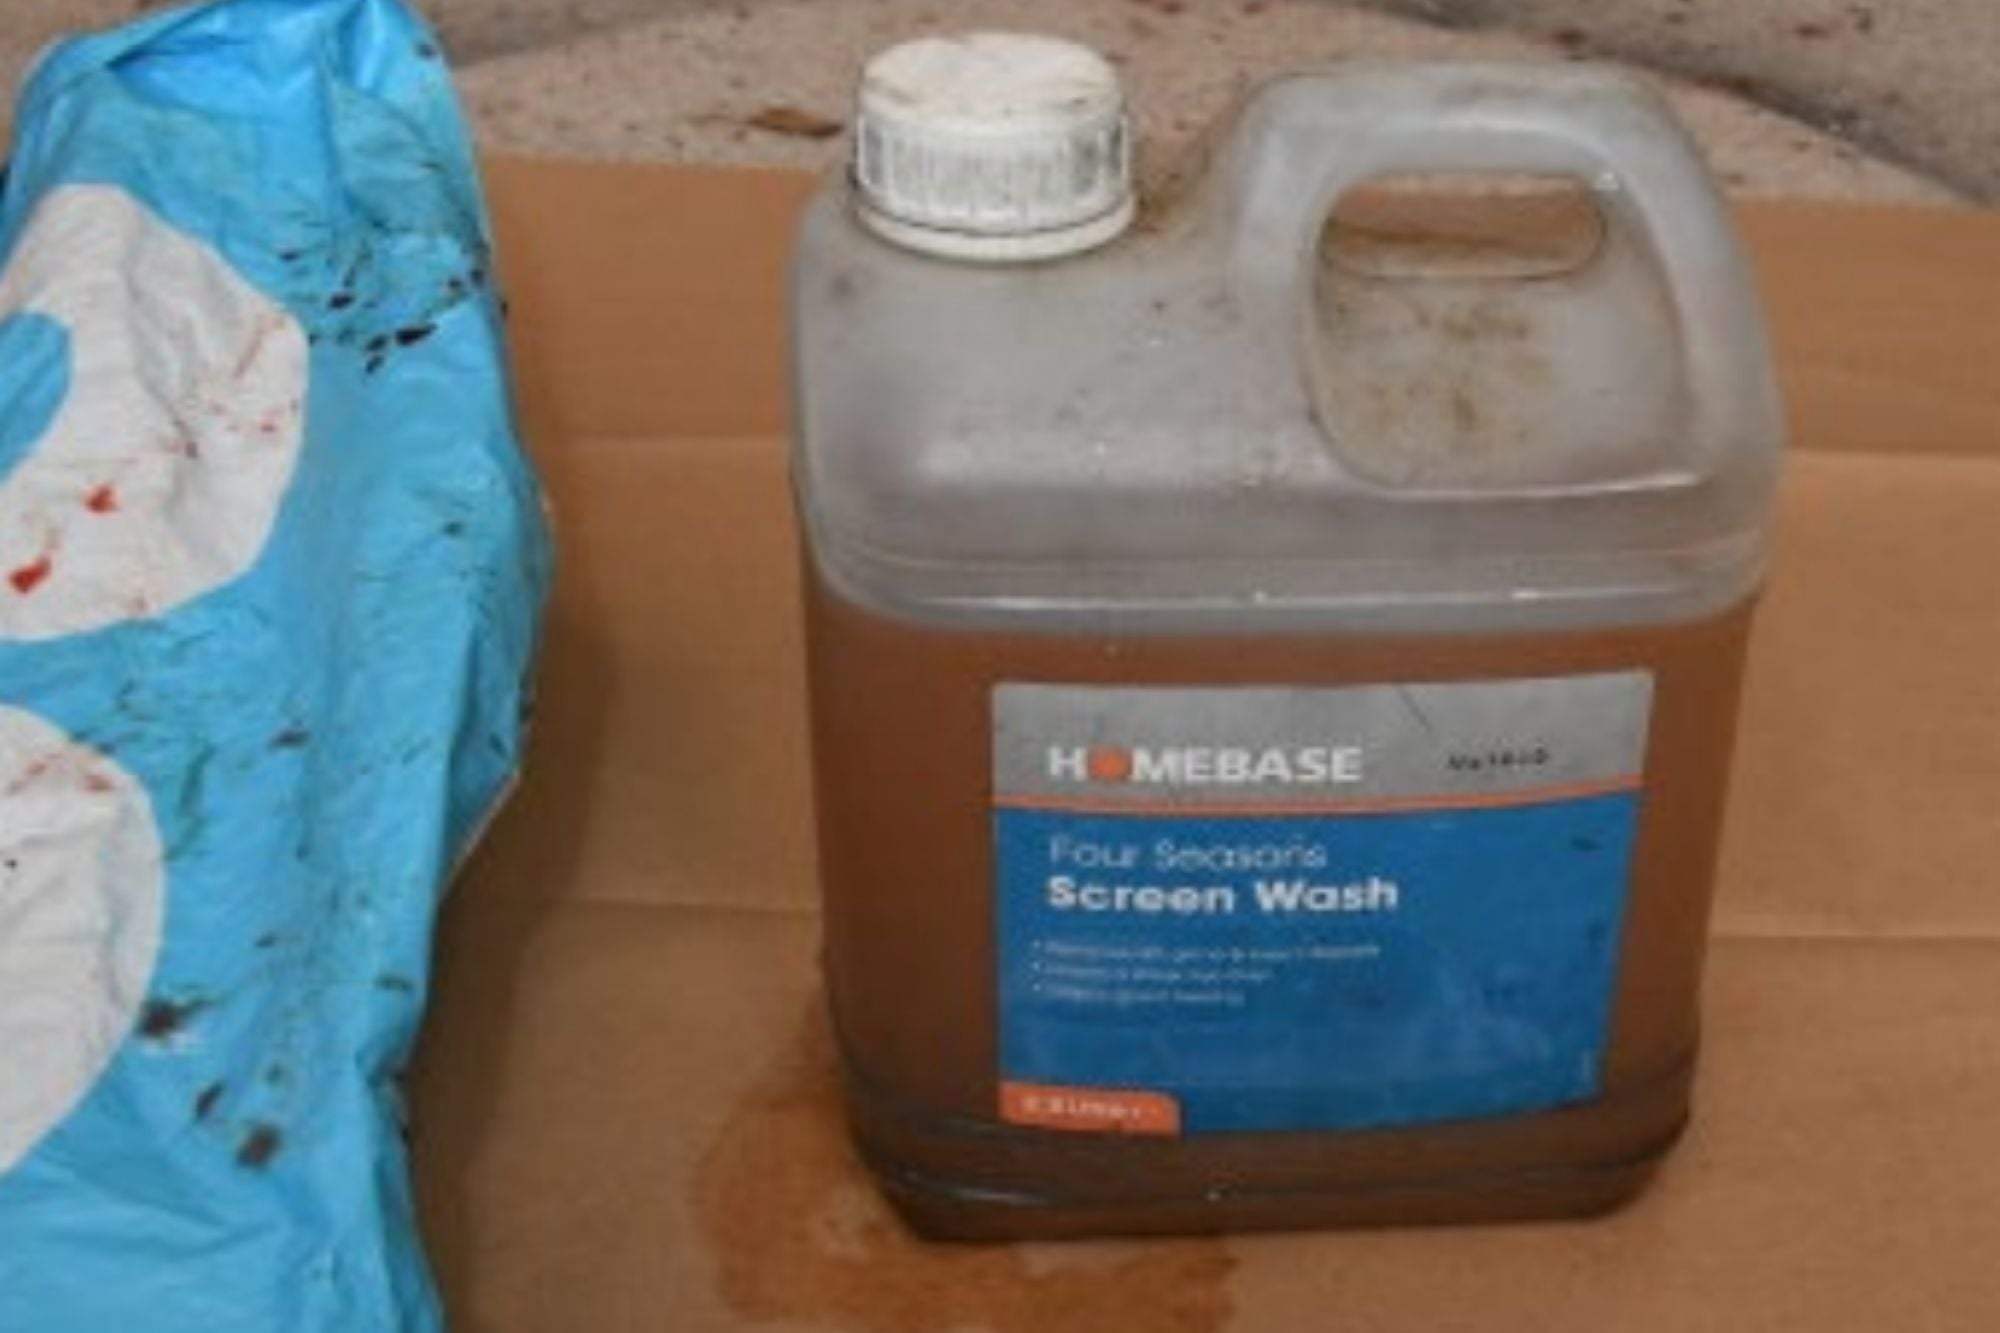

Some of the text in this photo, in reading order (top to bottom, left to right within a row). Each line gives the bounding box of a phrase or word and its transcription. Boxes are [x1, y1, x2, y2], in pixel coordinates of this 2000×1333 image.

[1049, 745, 1363, 783] HOMEBASE
[1049, 835, 1328, 871] Four Seasons
[1049, 875, 1398, 912] Screen Wash
